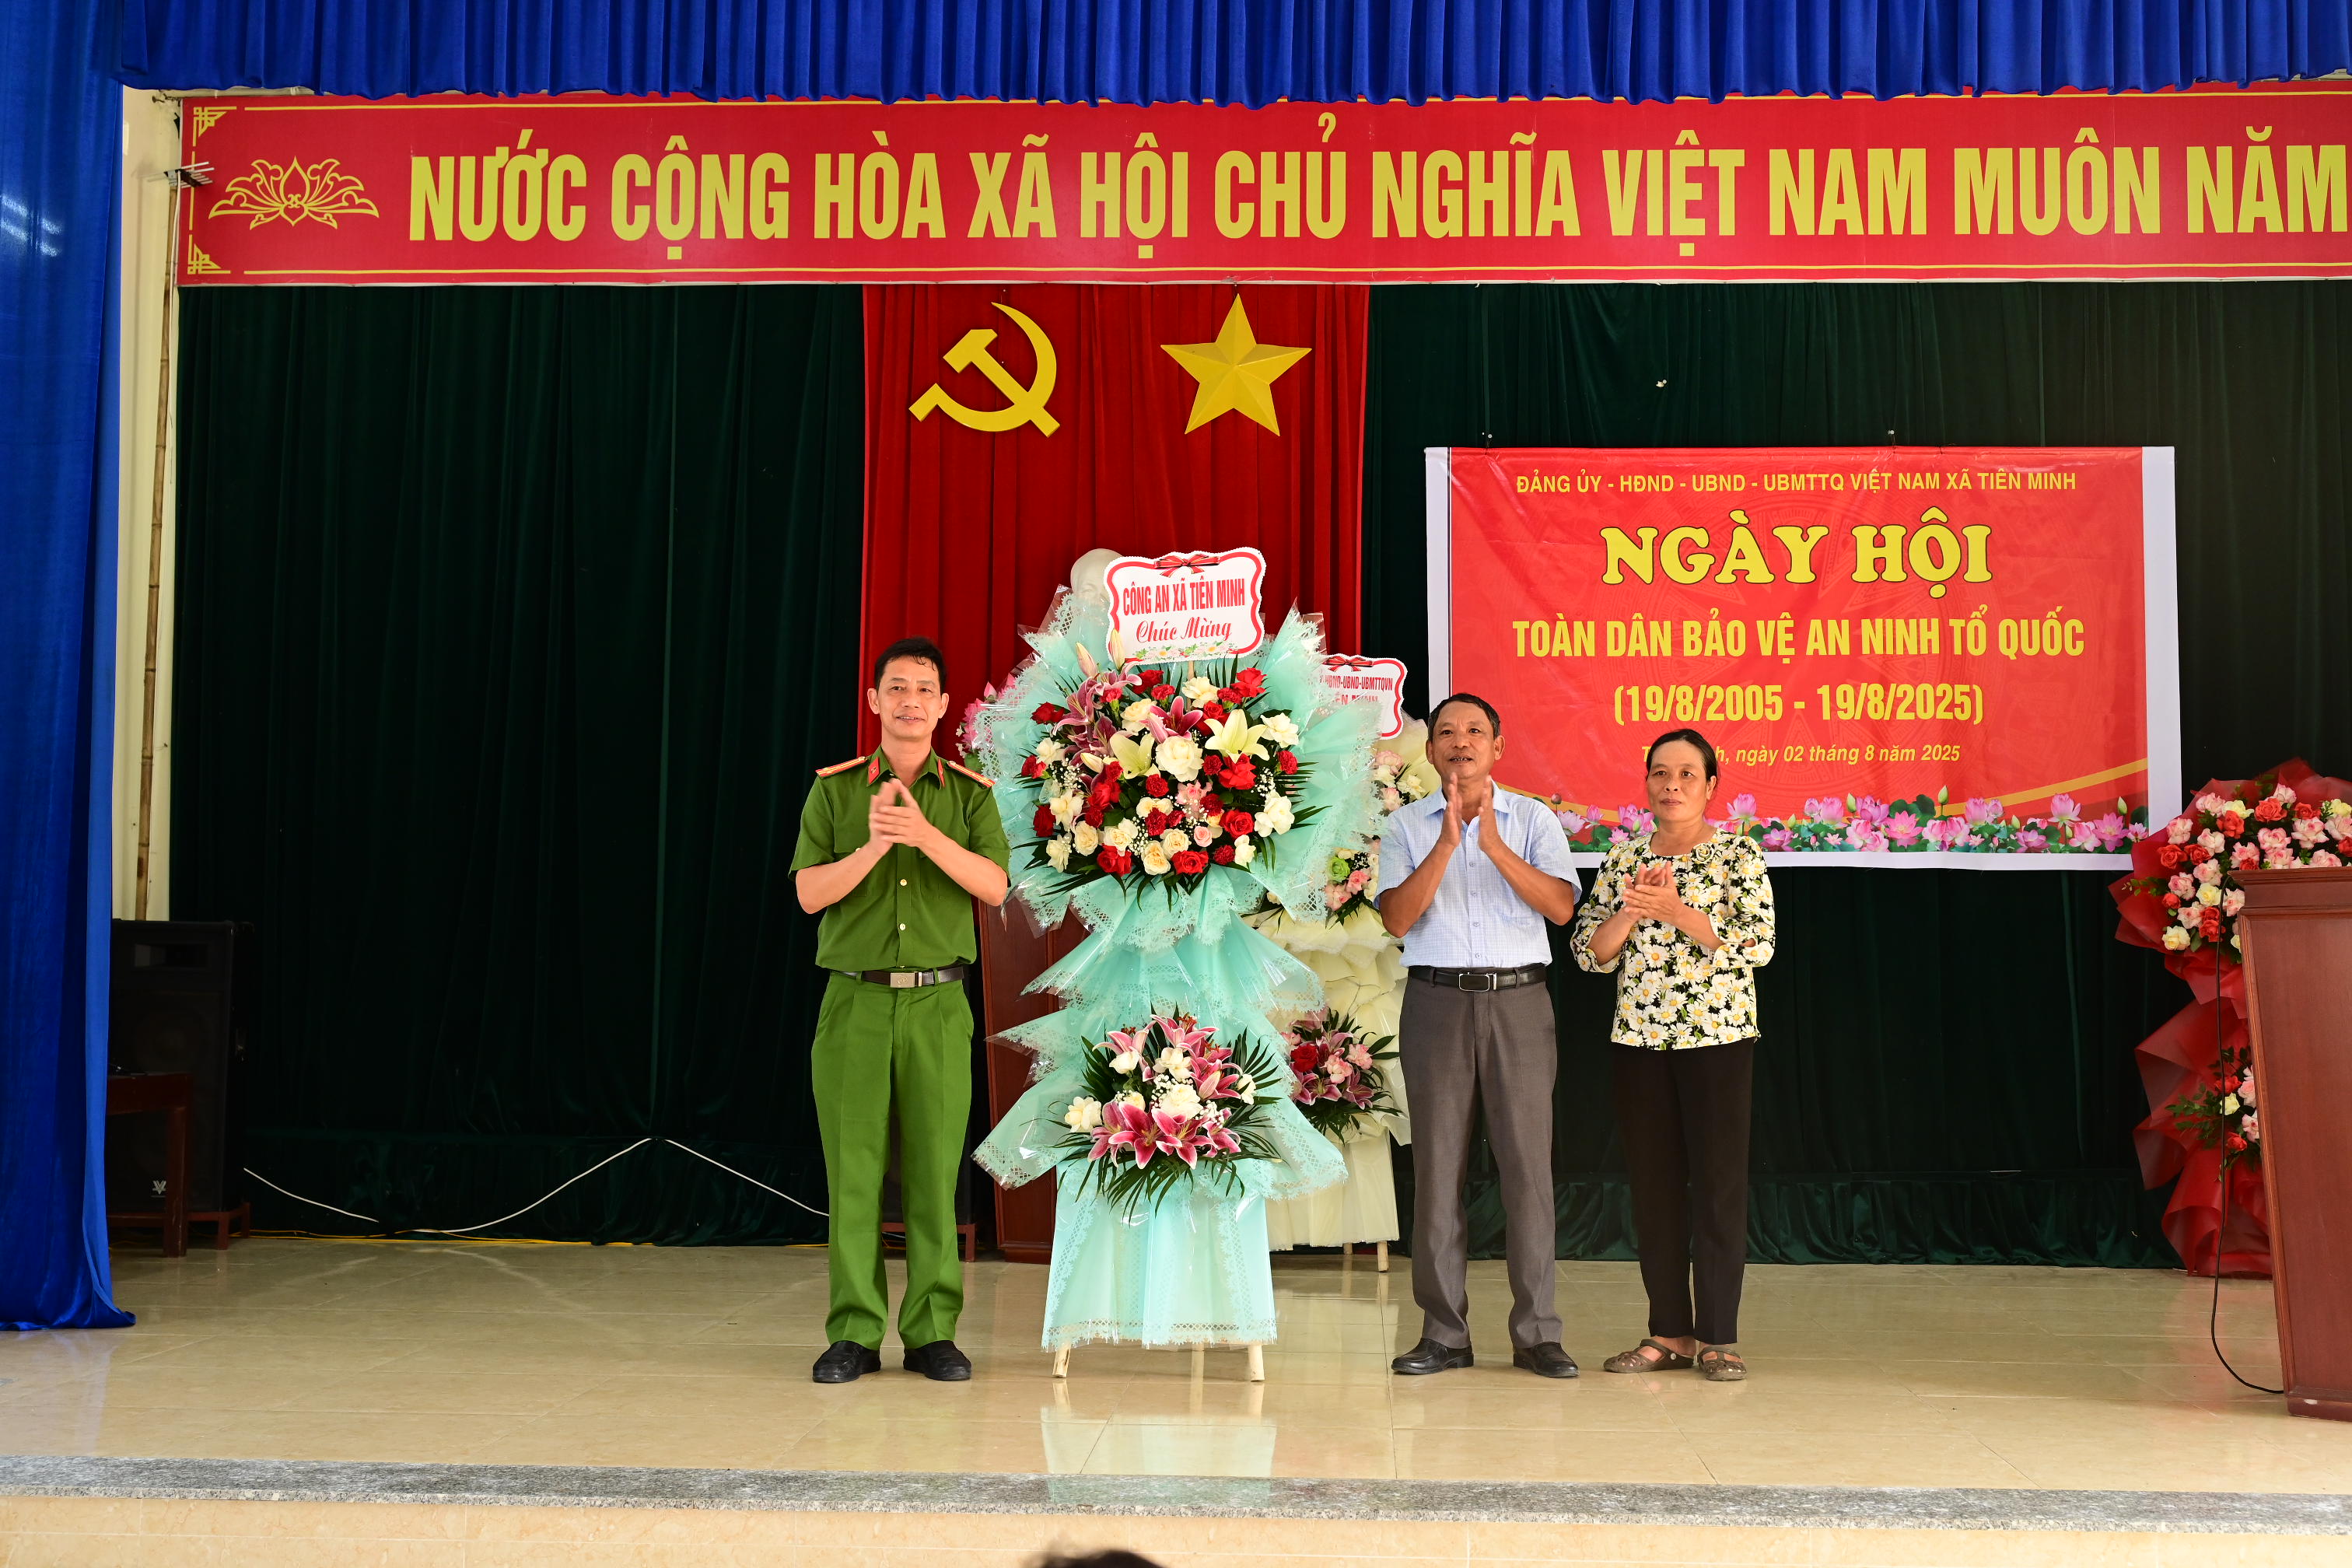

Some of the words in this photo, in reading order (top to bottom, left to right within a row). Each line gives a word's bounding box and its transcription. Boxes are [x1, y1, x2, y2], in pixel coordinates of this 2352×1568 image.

[411, 129, 586, 241] NƯỚC
[612, 135, 789, 260] CỘNG
[815, 131, 946, 239] HÒA
[968, 135, 1056, 237] XÃ
[1081, 133, 1188, 258] HỘI
[1215, 113, 1346, 239] CHỦ
[1373, 132, 1580, 238] NGHĨA
[1602, 130, 1745, 256] VIỆT
[1770, 149, 1927, 235] NAM
[1955, 128, 2160, 236] MUÔN
[2187, 126, 2347, 233] NĂM
[1517, 469, 1570, 492] ĐẢNG
[1578, 470, 1601, 492] ỦY
[1621, 475, 1674, 492] HĐND
[1692, 474, 1745, 492] UBND
[1764, 474, 1843, 491] UBMTTQ
[1850, 470, 1892, 493] VIỆT
[1899, 473, 1939, 489] NAM
[1947, 469, 1972, 489] XÃ
[1978, 468, 2020, 489] TIÊN
[2028, 473, 2075, 489] MINH
[1601, 510, 1828, 583] NGÀY
[1852, 507, 1991, 597] HỘI
[1123, 582, 1151, 616] CÔNG
[1155, 585, 1169, 613] AN
[1173, 578, 1187, 611] XÃ
[1190, 576, 1213, 610] TIÊN
[1216, 579, 1244, 607] MINH
[1136, 621, 1178, 643] Chúc
[1181, 616, 1232, 642] Mừng
[1513, 613, 1594, 656] TOÀN
[1607, 613, 1671, 656] DÂN
[1683, 608, 1745, 656] BẢO
[1756, 612, 1795, 663] VỆ
[1806, 619, 1850, 655] AN
[1861, 618, 1939, 655] NINH
[1949, 604, 1987, 656] TỔ
[1999, 606, 2084, 660] QUỐC
[1615, 684, 1783, 726] (19/8/2005
[1817, 683, 1983, 724] 19/8/2025)
[1736, 746, 1779, 766] ngày
[1784, 746, 1804, 761] 02
[1810, 745, 1859, 765] tháng
[1865, 745, 1874, 761] 8
[1880, 746, 1915, 761] năm
[1921, 744, 1960, 761] 2025
